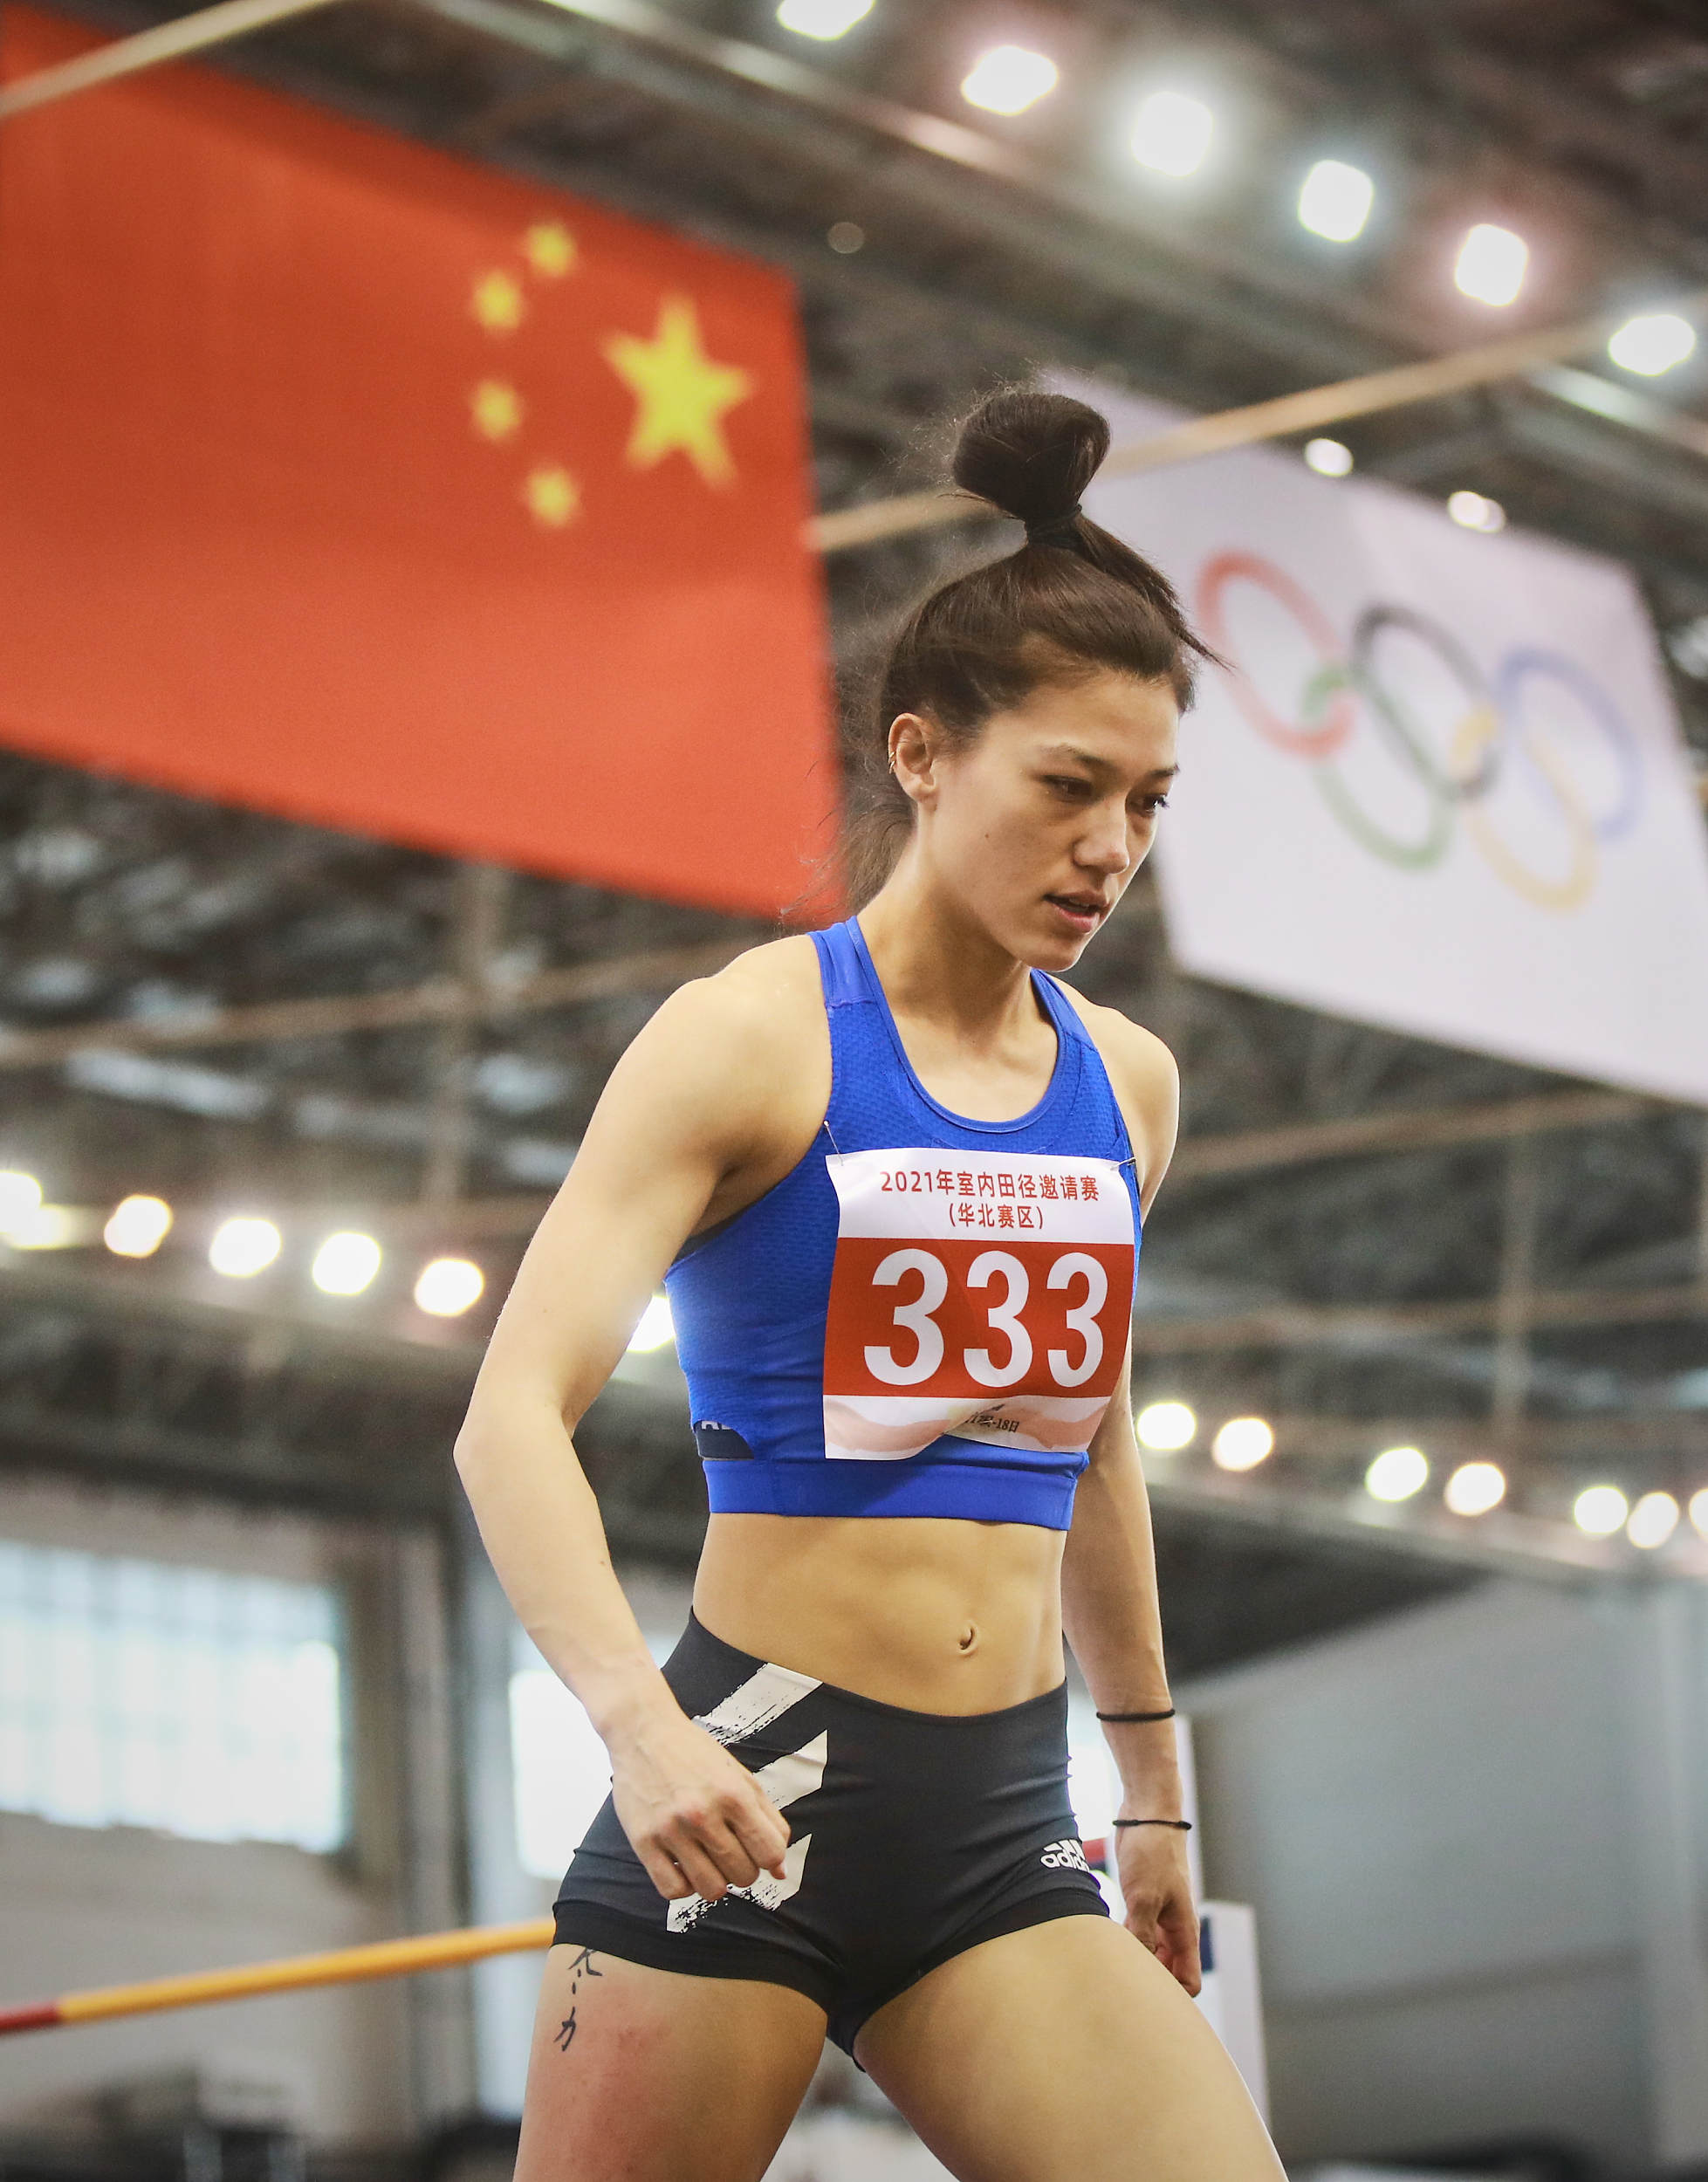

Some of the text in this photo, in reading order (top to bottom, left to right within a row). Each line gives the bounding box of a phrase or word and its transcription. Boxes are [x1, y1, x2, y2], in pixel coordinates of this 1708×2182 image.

[880, 1169, 1100, 1201] 2021年室内田径邀请赛
[949, 1203, 1044, 1230] (华北赛区)
[863, 1248, 1108, 1388] 333
